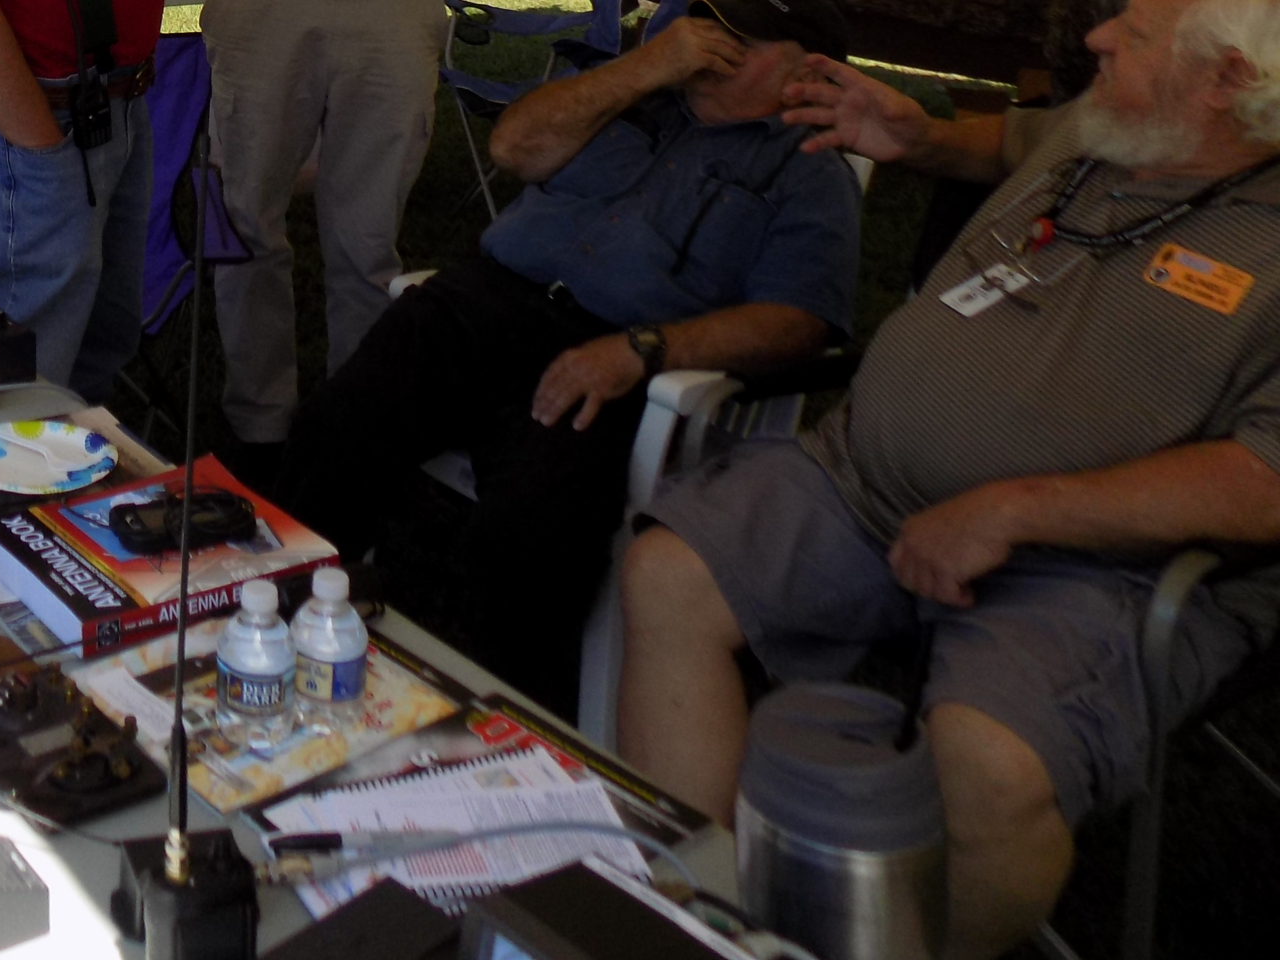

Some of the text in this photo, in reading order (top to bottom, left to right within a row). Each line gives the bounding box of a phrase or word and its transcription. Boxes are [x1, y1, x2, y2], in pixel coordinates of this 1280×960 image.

[0, 514, 55, 551] BOOK
[41, 545, 122, 608] ANTENNA
[158, 589, 229, 623] ANENNA
[242, 681, 281, 696] DEER
[242, 692, 281, 707] PARK
